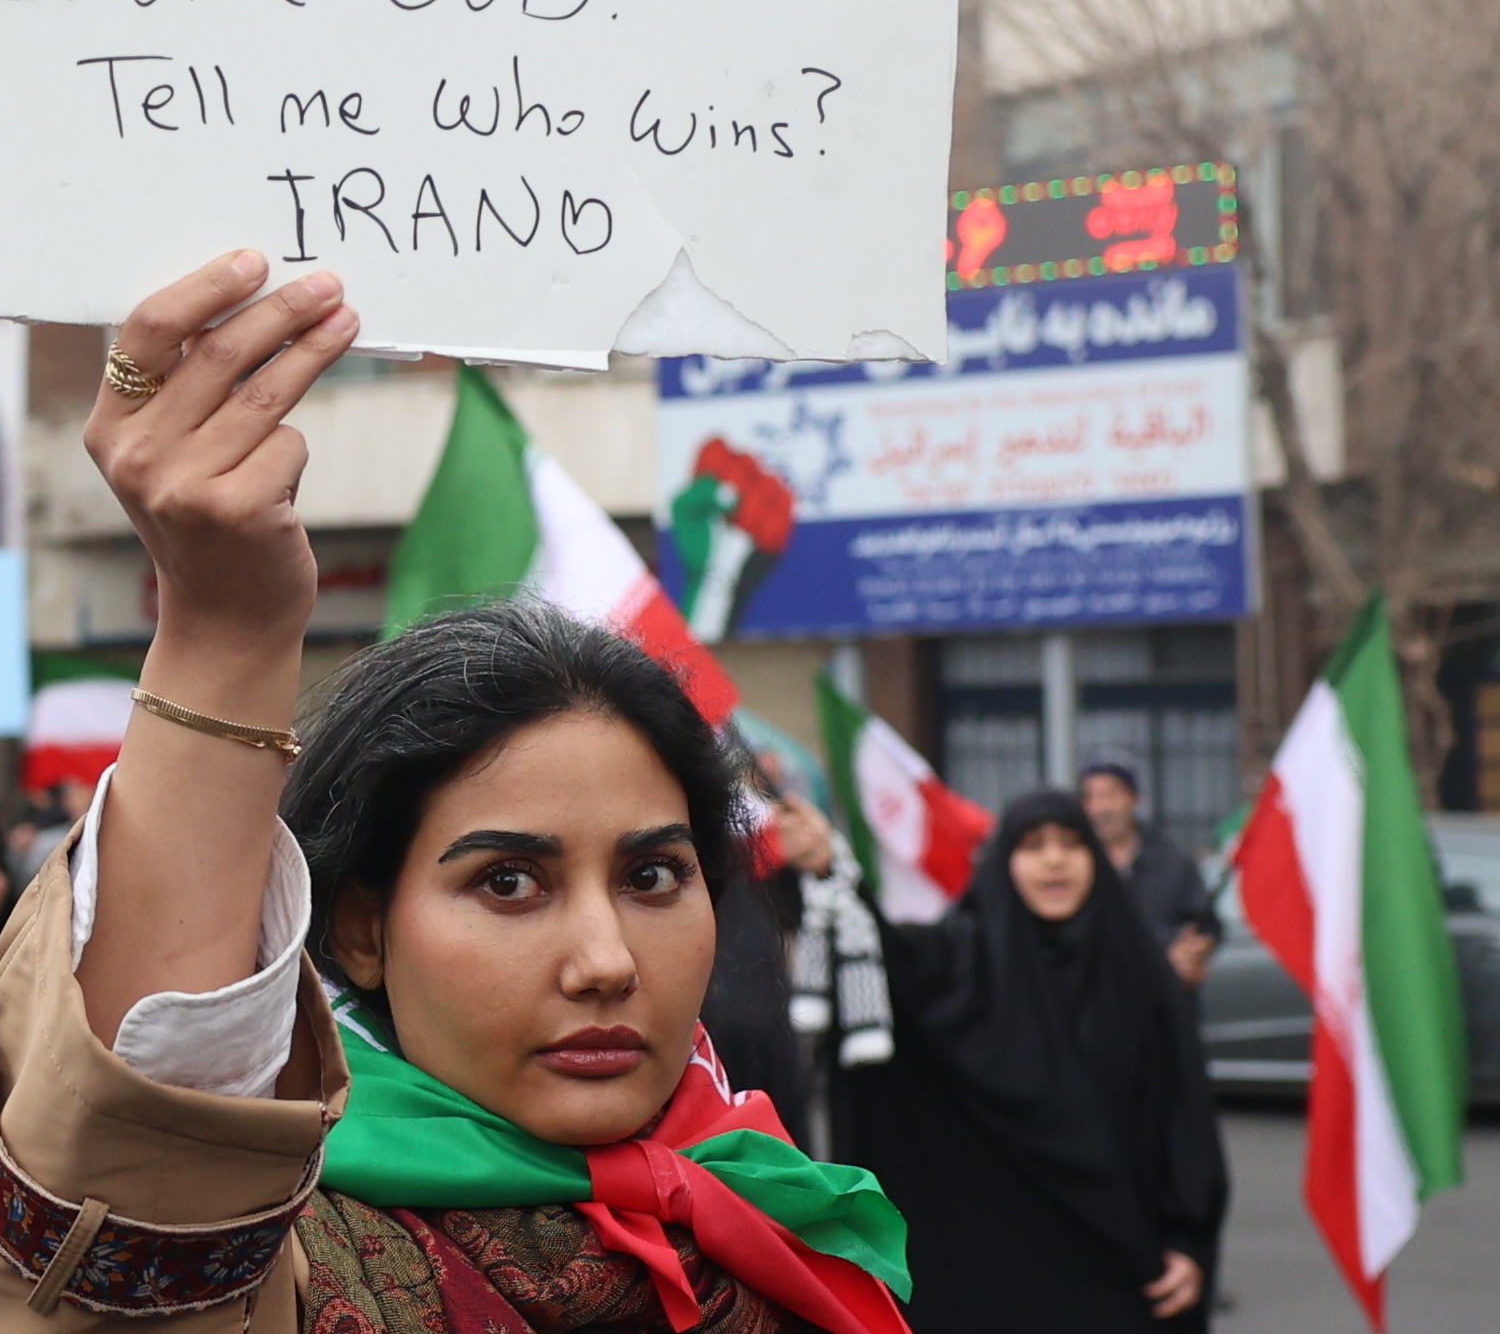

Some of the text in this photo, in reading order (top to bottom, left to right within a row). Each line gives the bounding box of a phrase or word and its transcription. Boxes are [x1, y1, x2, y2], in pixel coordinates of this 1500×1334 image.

[77, 56, 235, 138] Tell
[281, 90, 380, 135] me
[267, 167, 540, 262] IRAN
